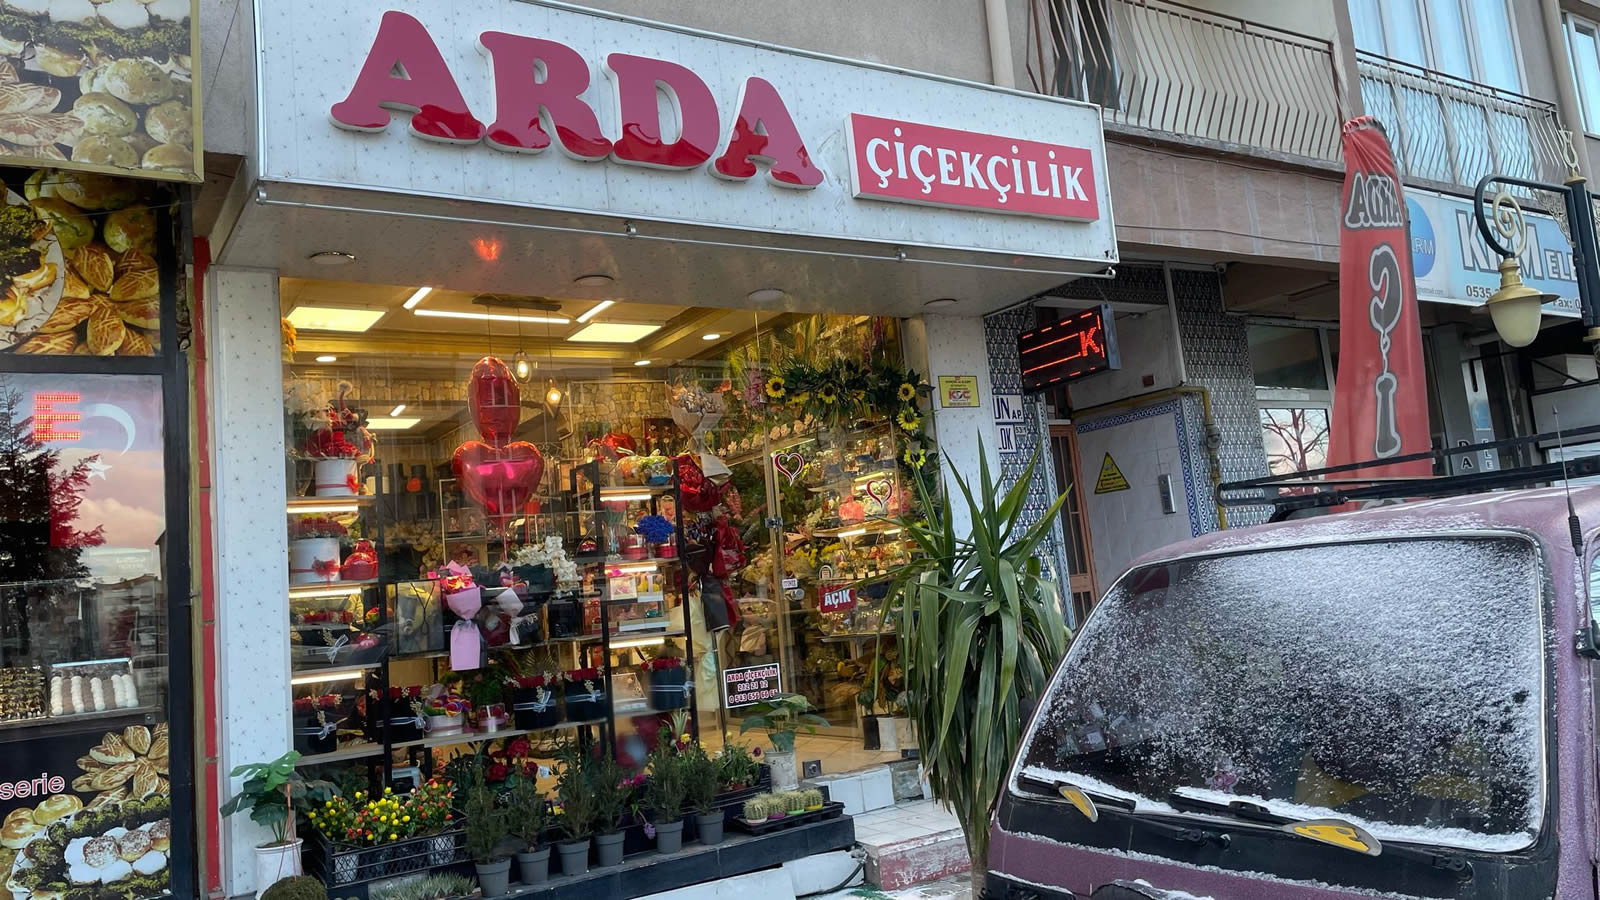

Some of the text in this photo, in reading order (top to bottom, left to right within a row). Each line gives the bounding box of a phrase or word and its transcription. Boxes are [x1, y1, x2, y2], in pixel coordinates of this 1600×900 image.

[328, 10, 824, 190] ARDA
[866, 127, 1088, 203] ÇİÇEKÇİLİK
[1080, 326, 1100, 357] K
[824, 588, 851, 608] AÇIK
[727, 672, 744, 682] ARDA
